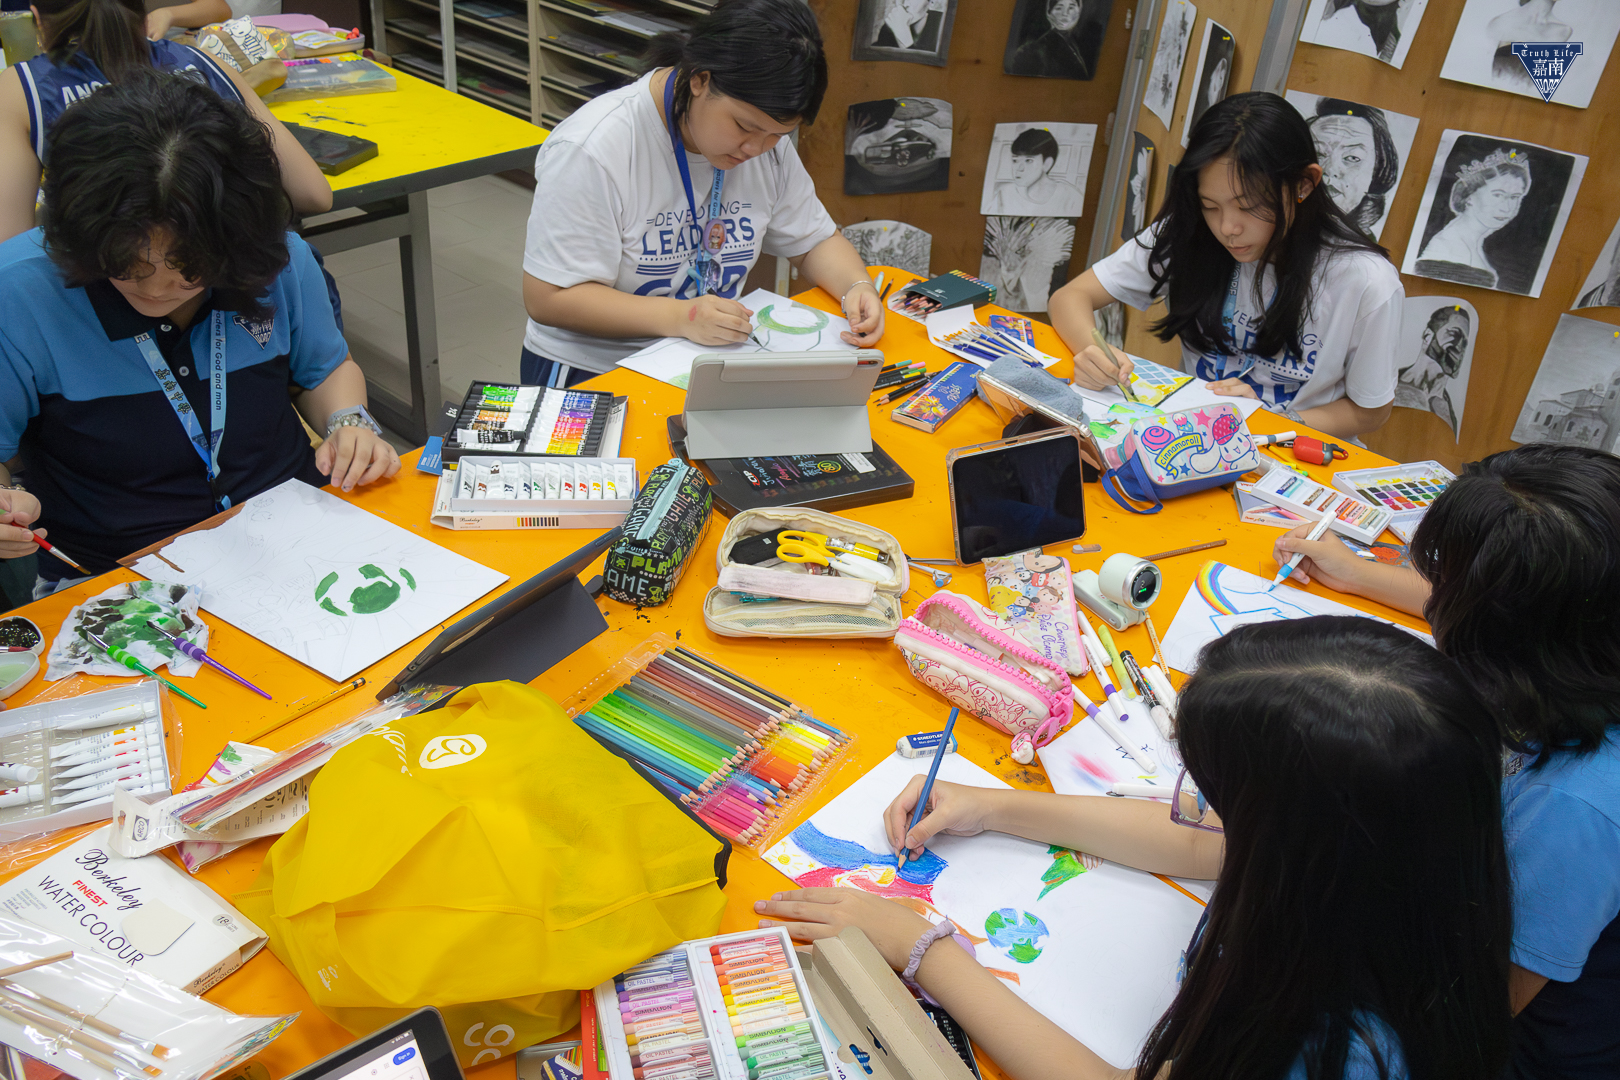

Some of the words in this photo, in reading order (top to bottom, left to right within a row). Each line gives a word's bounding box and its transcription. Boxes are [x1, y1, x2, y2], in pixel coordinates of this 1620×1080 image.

[642, 217, 755, 256] LEADRS
[215, 353, 223, 374] God
[215, 374, 223, 390] and
[215, 392, 223, 411] man
[1160, 436, 1199, 466] cinnamoroll
[136, 819, 146, 838] ARCO
[75, 848, 144, 911] Berkeley
[71, 879, 109, 908] FINEST
[37, 876, 86, 919] WATER
[79, 912, 145, 967] COLOUR
[728, 957, 764, 968] SIMBALION
[639, 977, 656, 986] PASTEL
[729, 968, 766, 980] SIMBALION
[733, 976, 770, 988] SIMBALION
[635, 1004, 672, 1016] SIMBALION
[749, 1027, 786, 1039] SIMBALION
[645, 1051, 654, 1059] OIL
[654, 1049, 675, 1057] PASTEL
